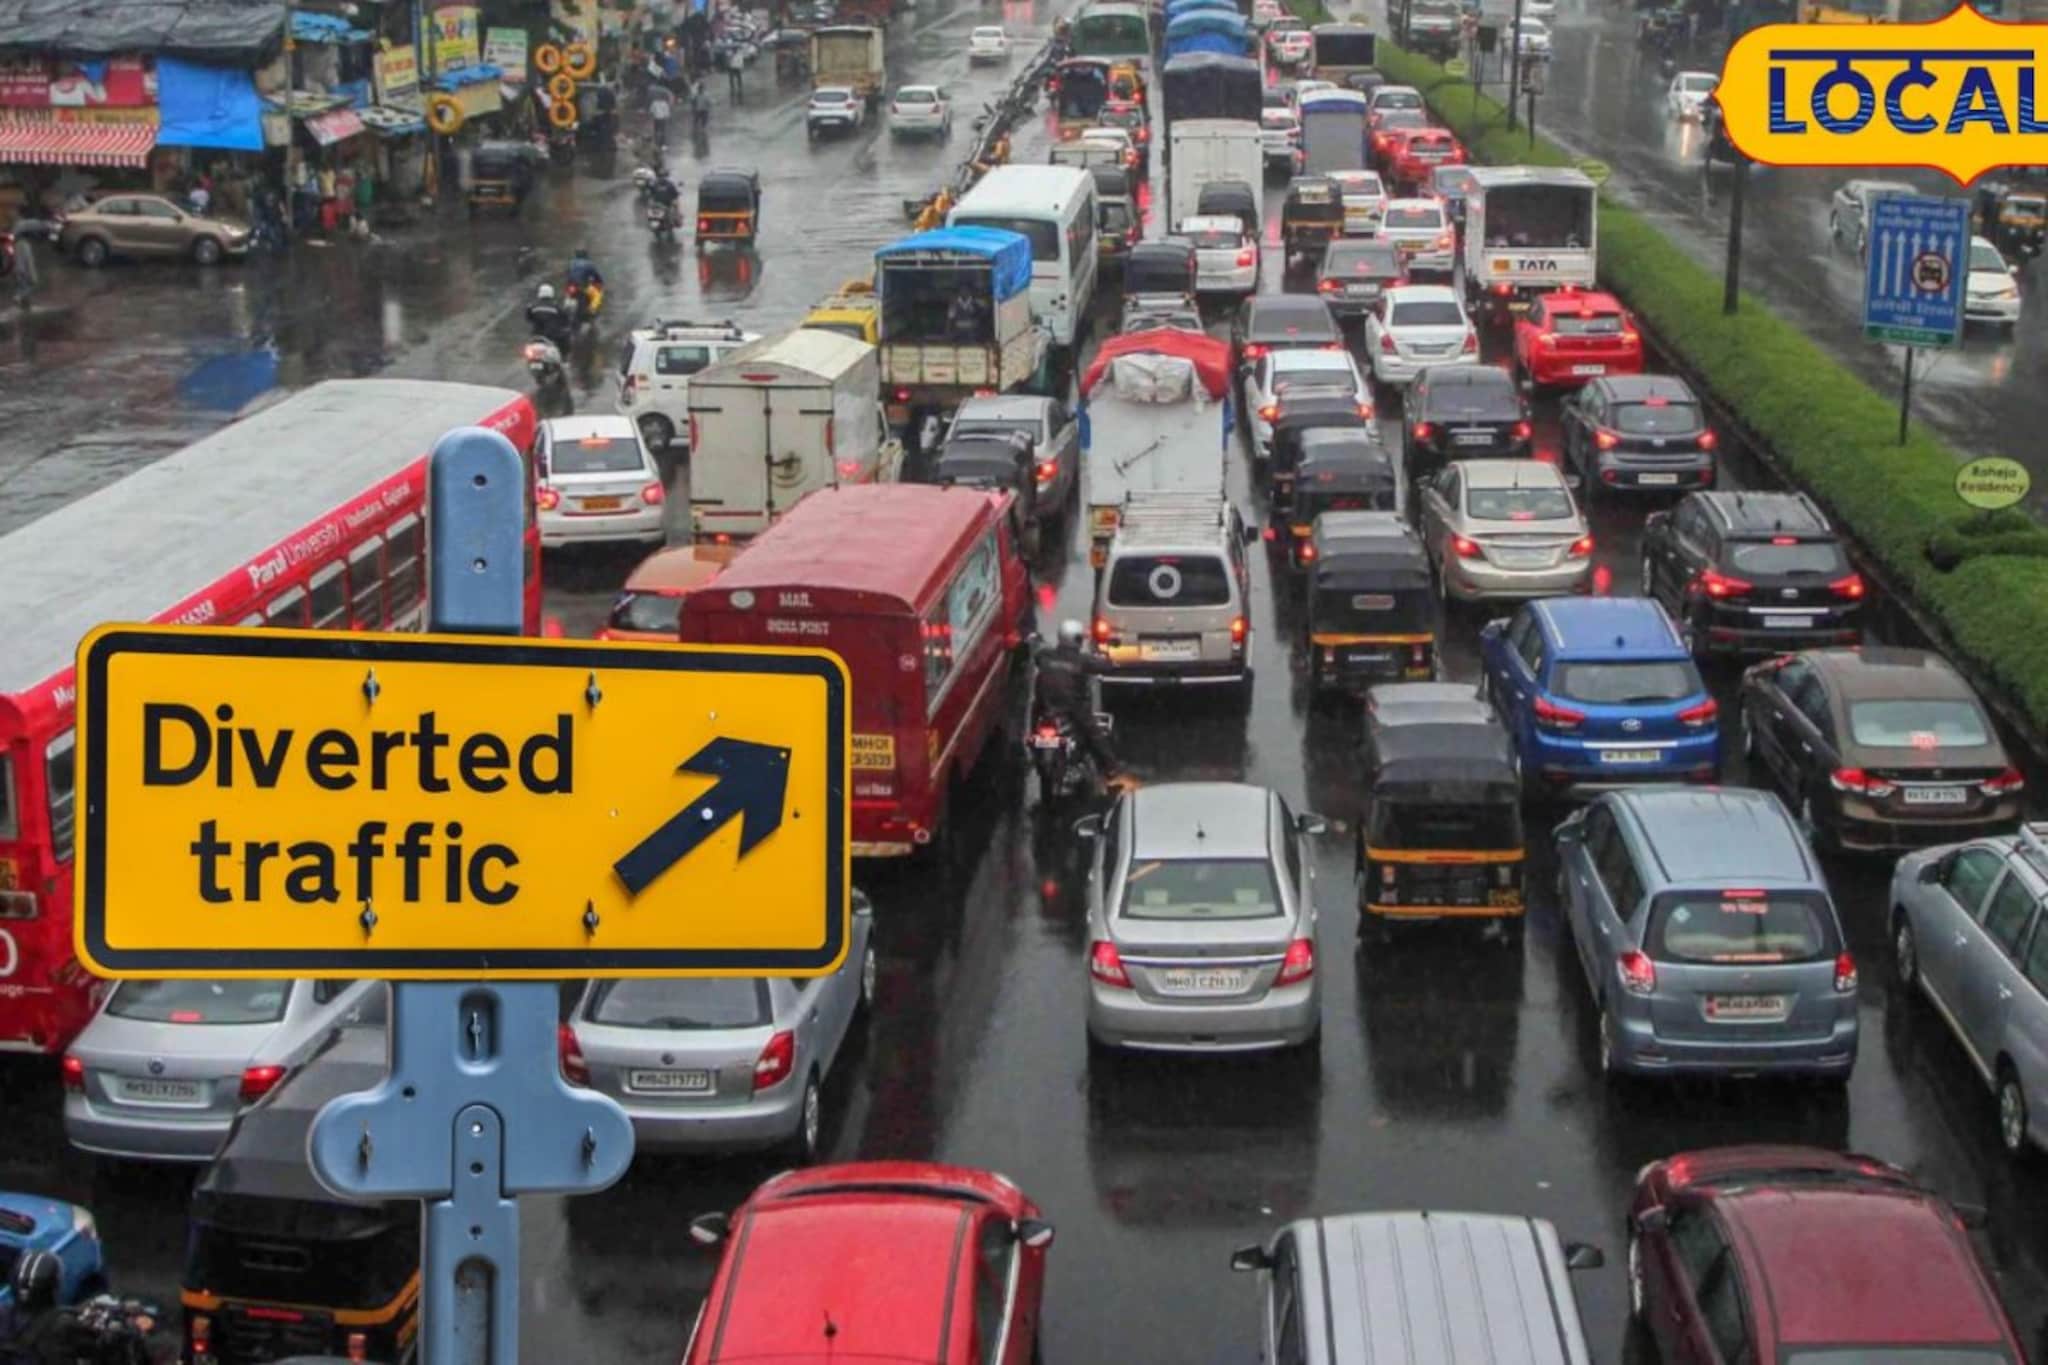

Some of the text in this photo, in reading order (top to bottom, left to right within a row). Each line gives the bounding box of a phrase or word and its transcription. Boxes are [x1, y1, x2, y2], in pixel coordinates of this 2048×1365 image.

[1518, 259, 1557, 271] TATA
[1960, 481, 2025, 494] Residency
[246, 551, 289, 592] Parul
[287, 522, 341, 565] University
[766, 618, 830, 636] INDIA POST
[143, 702, 575, 794] Diverted
[190, 819, 521, 905] traffic
